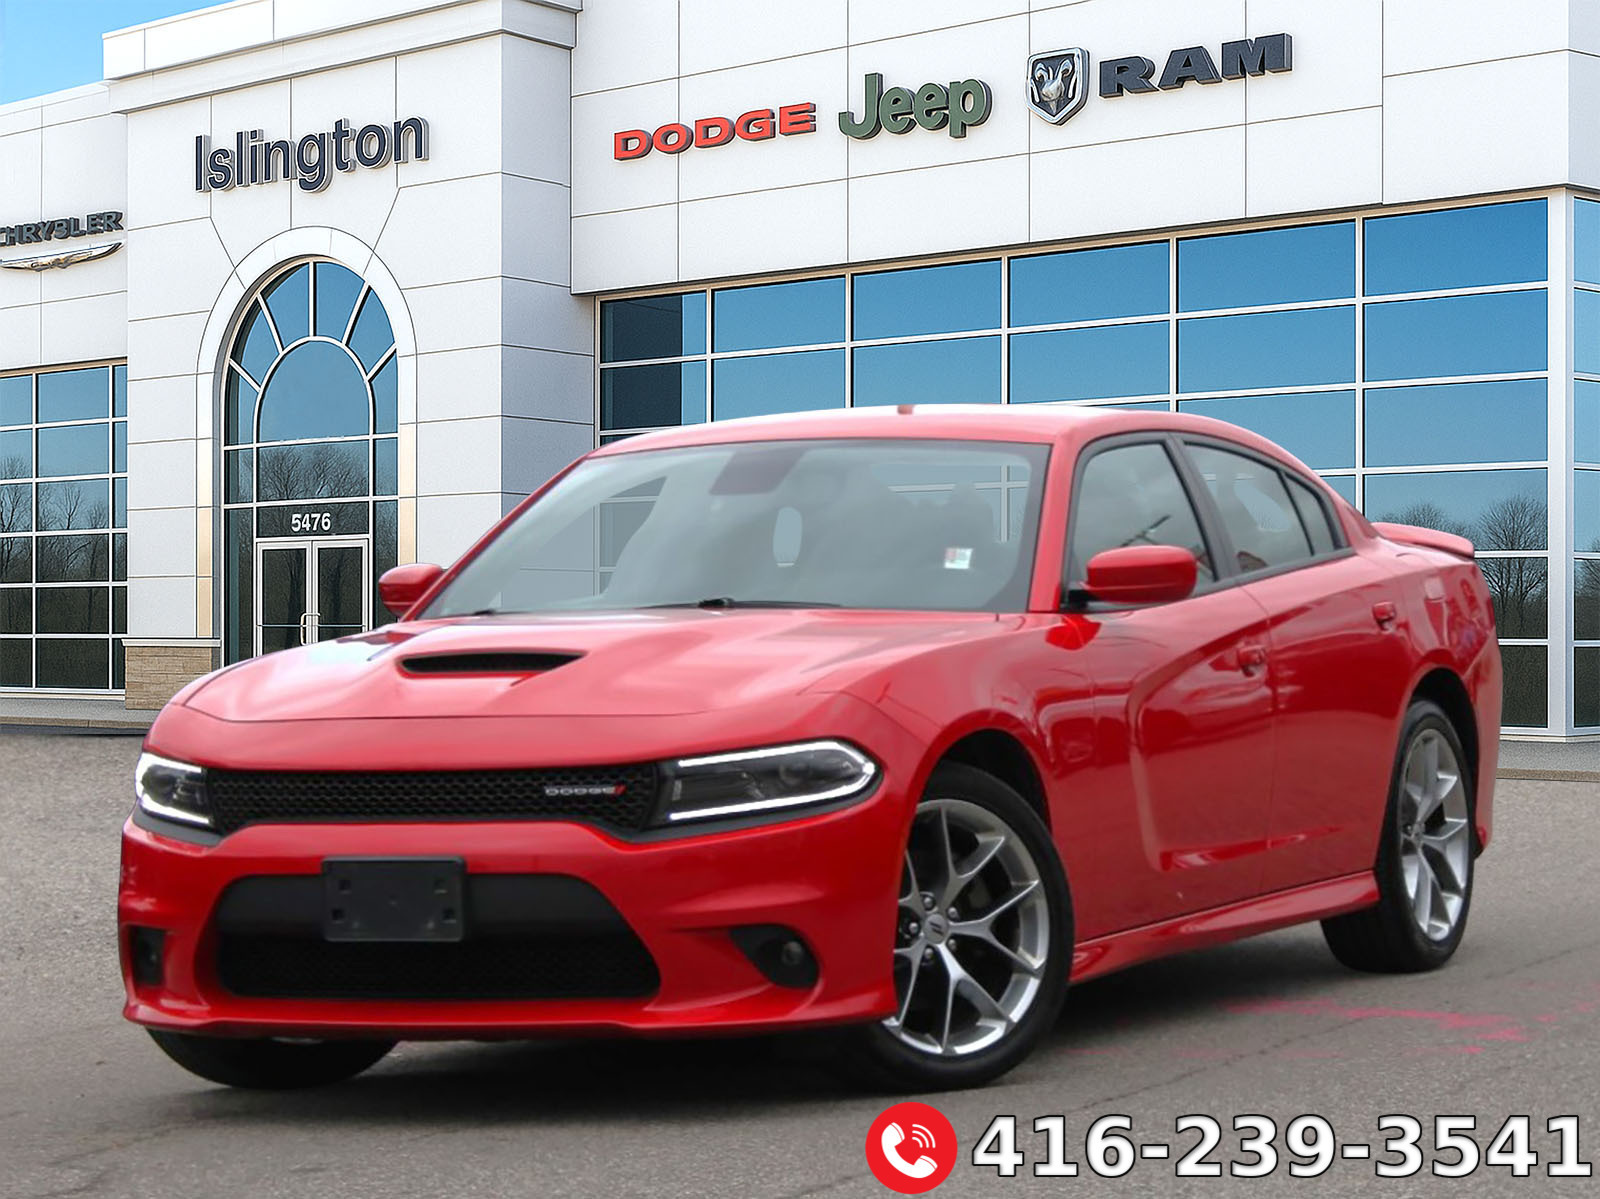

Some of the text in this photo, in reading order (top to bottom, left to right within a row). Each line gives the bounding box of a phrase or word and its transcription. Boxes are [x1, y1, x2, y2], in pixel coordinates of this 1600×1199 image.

[1099, 33, 1293, 99] RAM
[614, 102, 817, 161] DODGE
[839, 72, 993, 140] Jeep
[195, 116, 429, 193] Islington
[291, 512, 331, 532] 5476
[544, 785, 616, 796] DODGE
